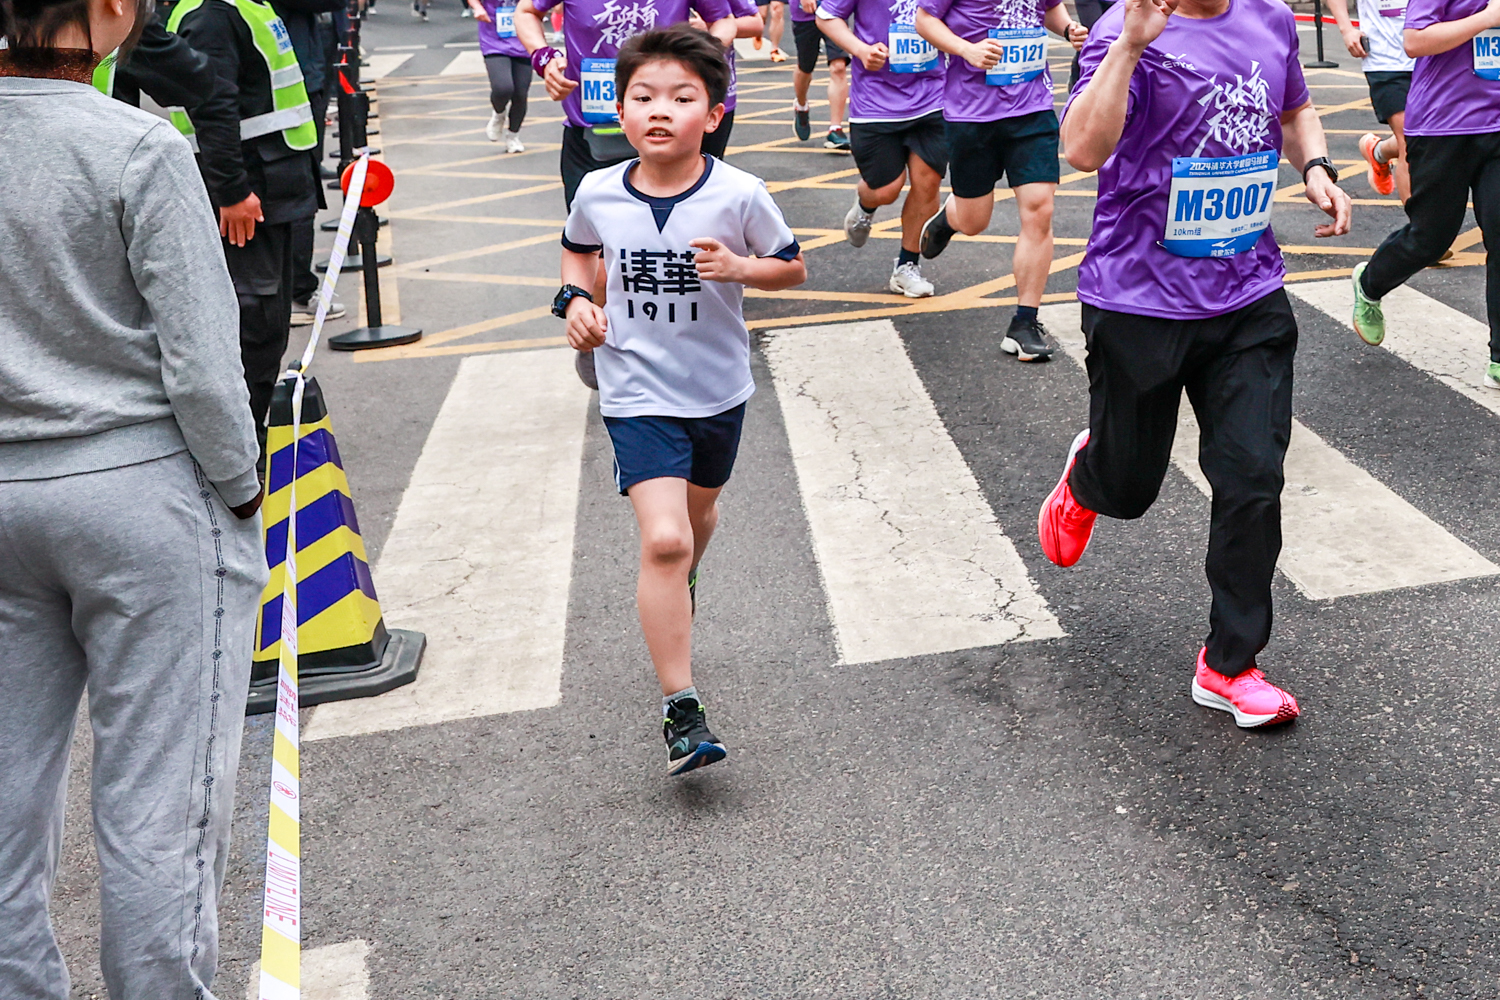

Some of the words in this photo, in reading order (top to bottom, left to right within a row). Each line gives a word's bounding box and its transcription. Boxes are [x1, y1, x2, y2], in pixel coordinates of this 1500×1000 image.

[502, 17, 512, 25] F5
[584, 80, 615, 101] M3
[1174, 181, 1274, 222] M3007
[627, 299, 698, 323] 1911
